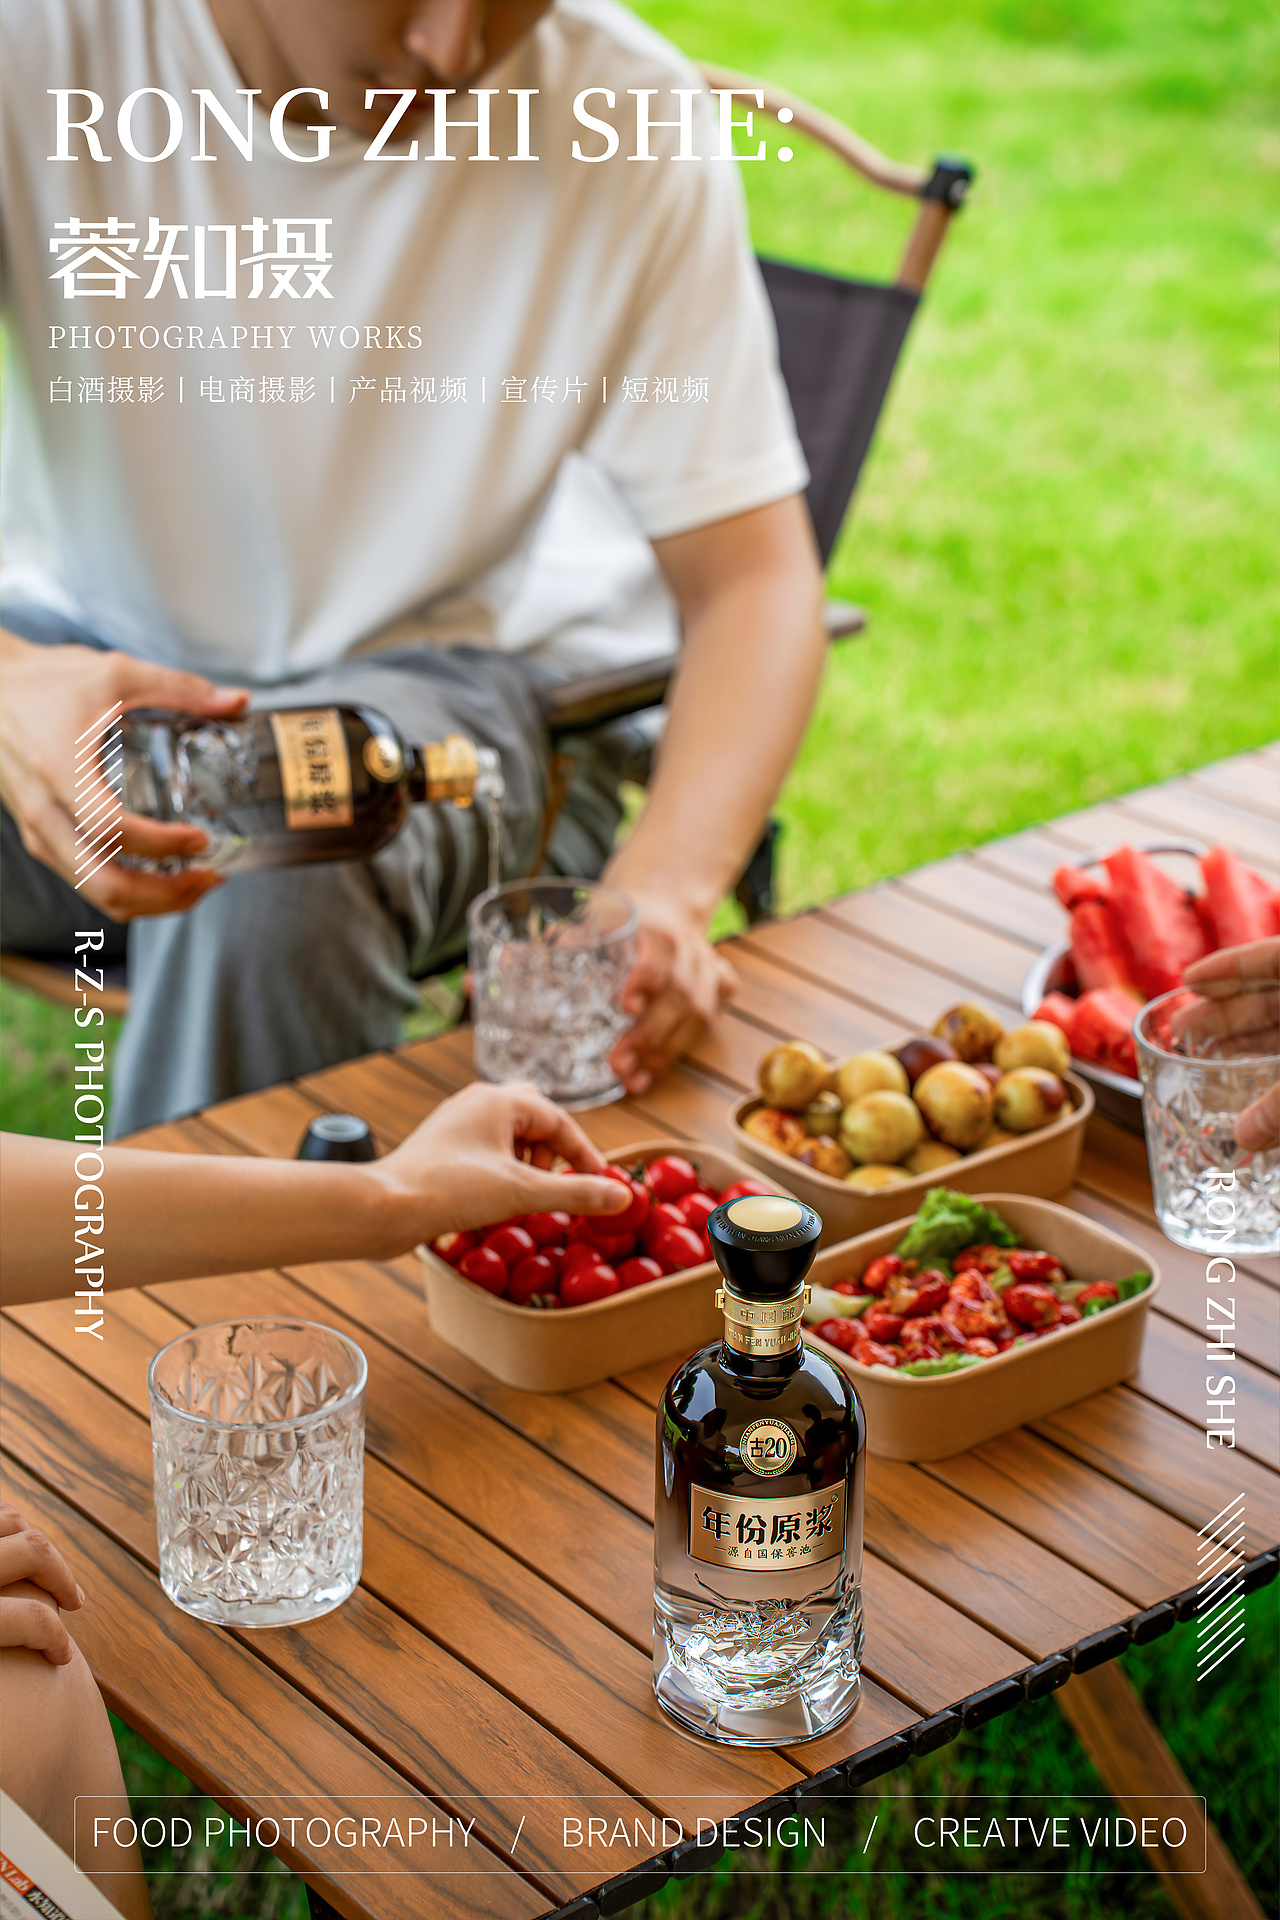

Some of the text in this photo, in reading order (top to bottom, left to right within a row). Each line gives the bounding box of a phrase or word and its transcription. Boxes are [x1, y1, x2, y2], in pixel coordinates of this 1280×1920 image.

[749, 1437, 787, 1459] 古20
[701, 1504, 834, 1546] 年份原浆
